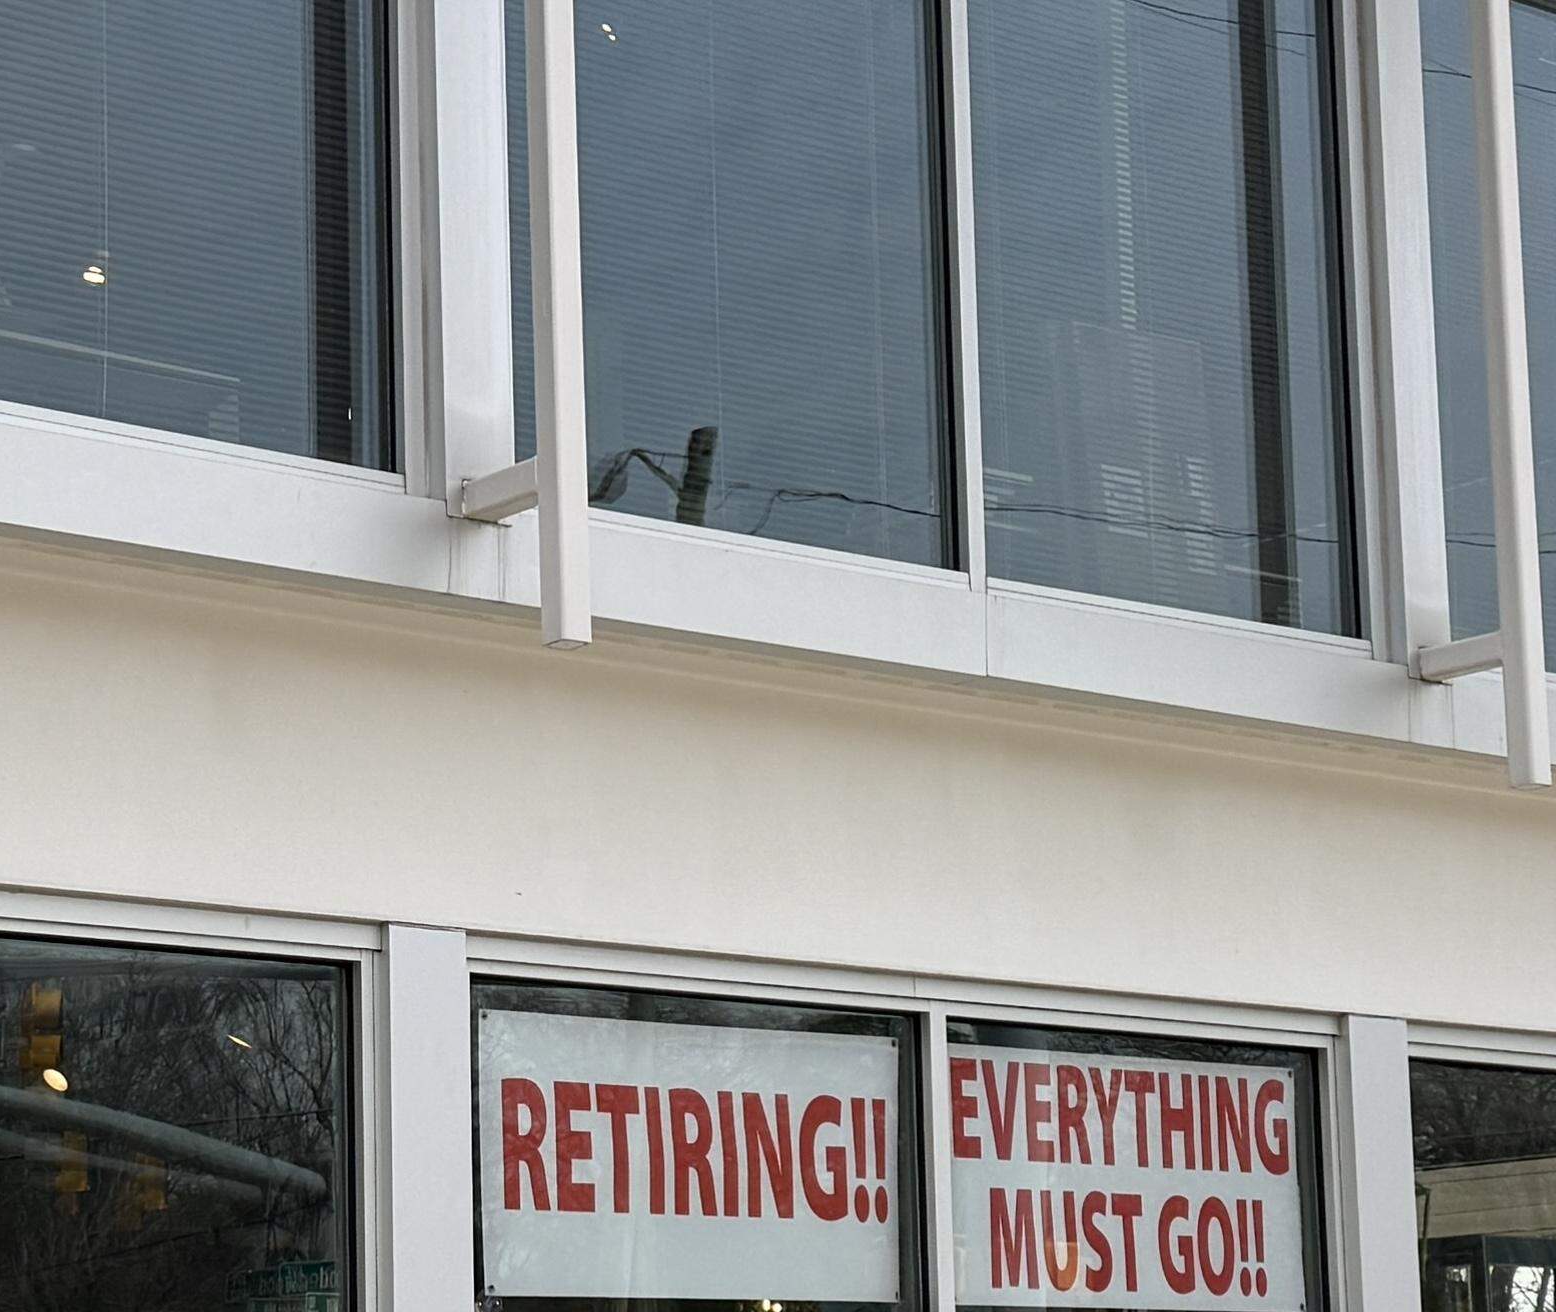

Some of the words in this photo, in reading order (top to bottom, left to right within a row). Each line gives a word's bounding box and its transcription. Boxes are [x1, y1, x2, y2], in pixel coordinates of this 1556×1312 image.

[501, 1077, 889, 1225] RETIRING!!
[950, 1056, 1290, 1176] EVERYTHING
[989, 1187, 1143, 1294] MUST
[1157, 1194, 1268, 1299] GO!!
